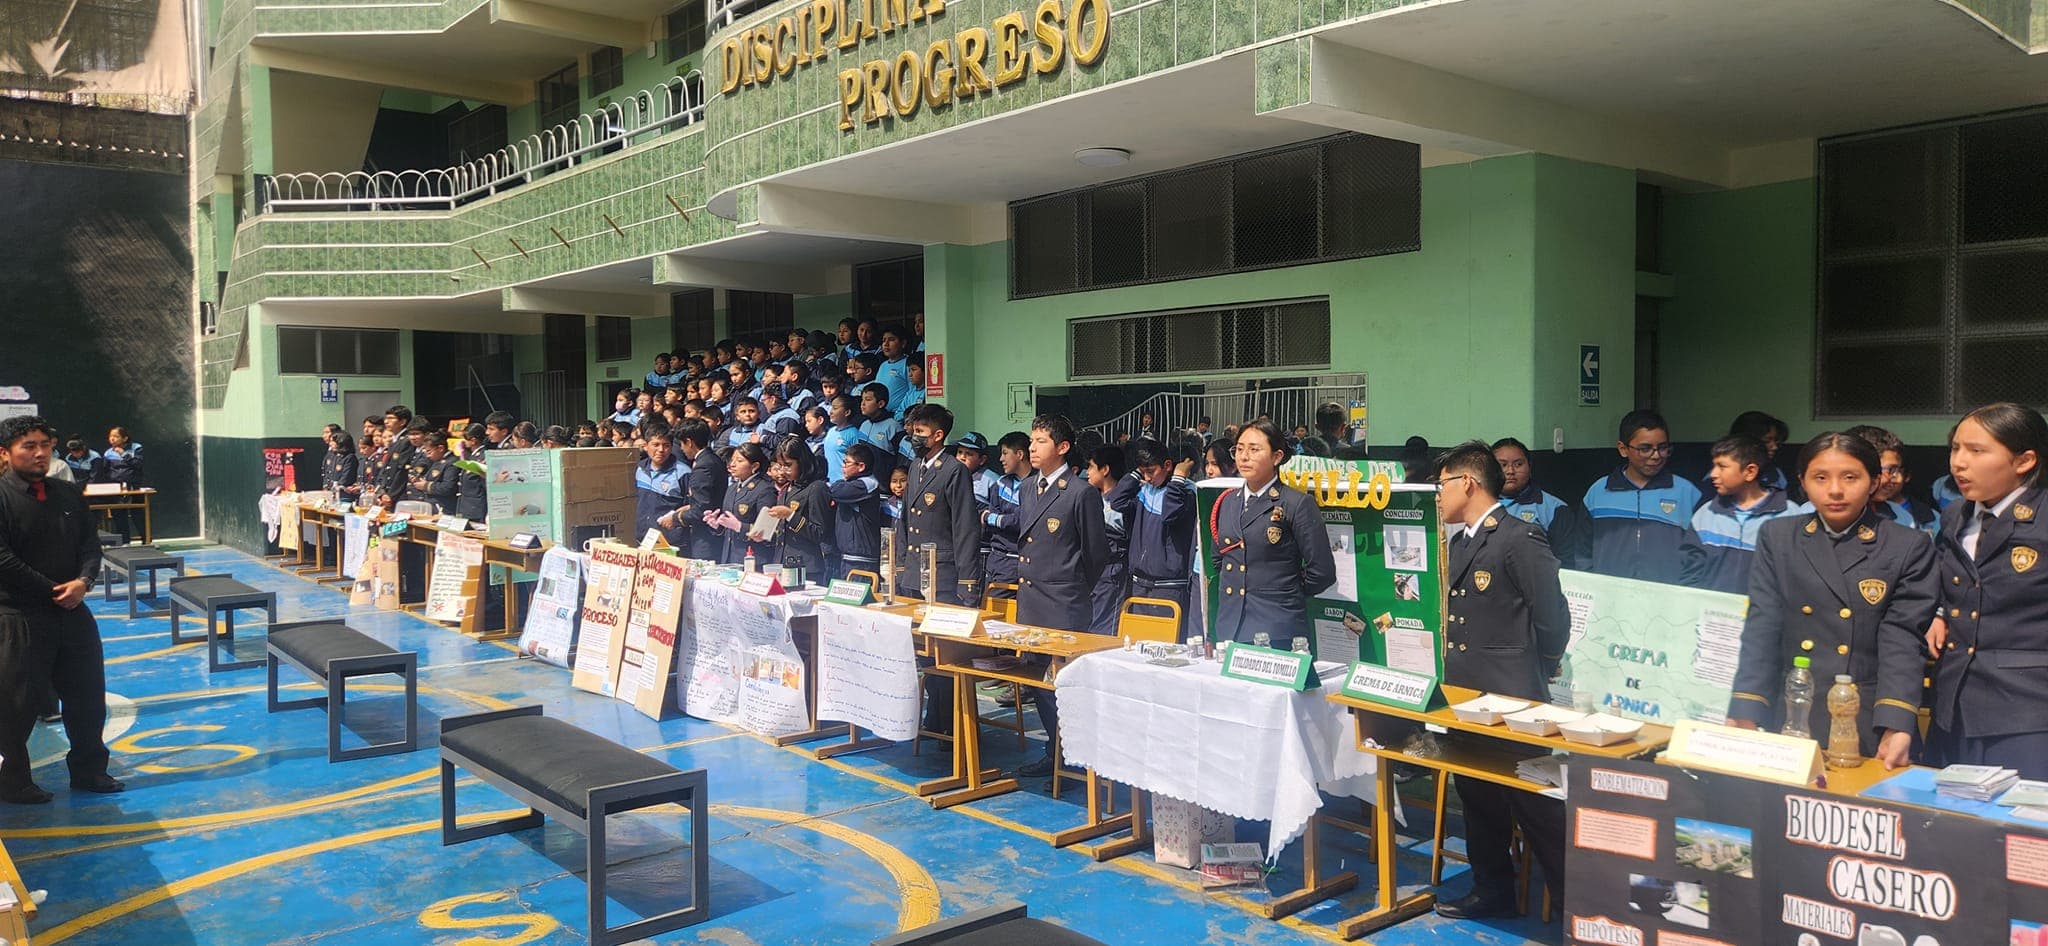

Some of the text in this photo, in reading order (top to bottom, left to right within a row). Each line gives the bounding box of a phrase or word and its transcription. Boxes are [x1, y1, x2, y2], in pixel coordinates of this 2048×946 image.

[838, 0, 1111, 131] PROGRESO
[1385, 509, 1424, 519] CONCLUSIÓN
[582, 607, 618, 627] PROCESO
[1396, 618, 1423, 628] POMADA
[1232, 655, 1263, 672] UTILIDADES
[1272, 662, 1297, 678] TOMILLO
[1608, 642, 1668, 669] CREMA
[1353, 674, 1381, 689] CREMA
[1381, 680, 1394, 692] DE
[1625, 677, 1641, 690] DE
[1788, 797, 1903, 857] BIODESEL
[1832, 859, 1951, 918] CASERO
[1783, 899, 1853, 938] MATERIALES
